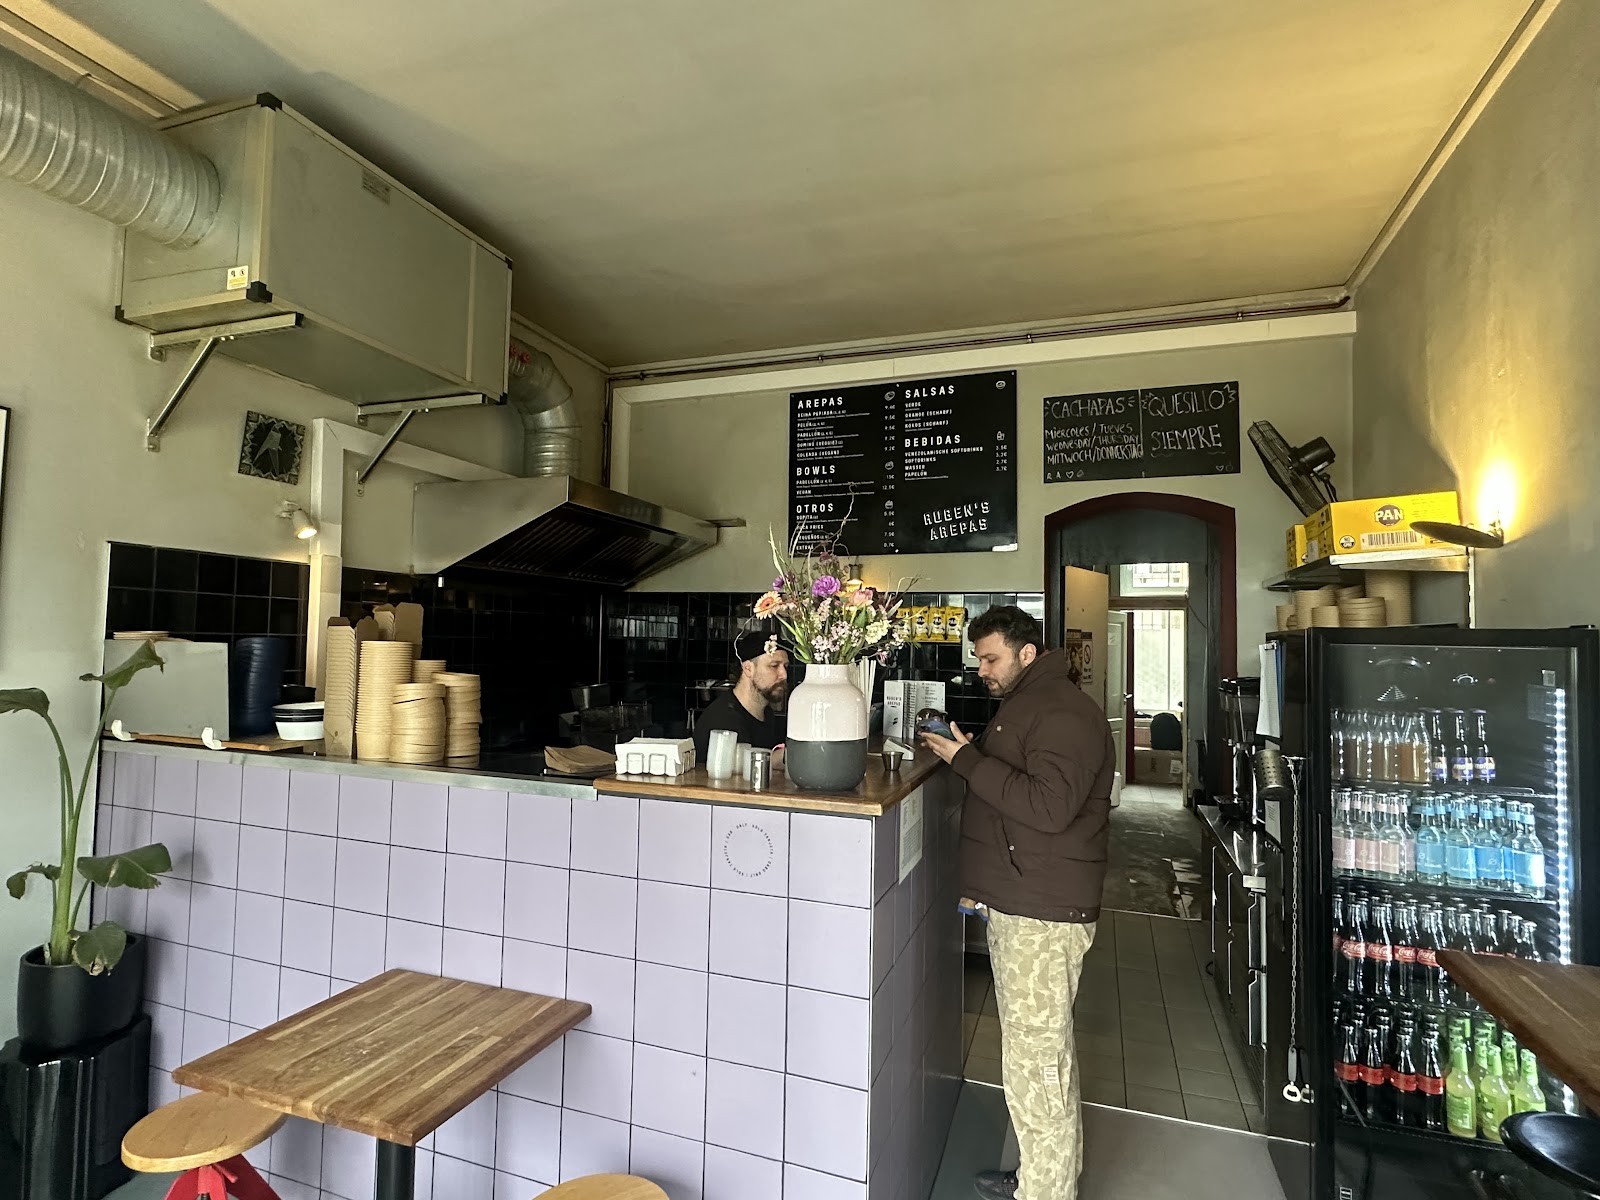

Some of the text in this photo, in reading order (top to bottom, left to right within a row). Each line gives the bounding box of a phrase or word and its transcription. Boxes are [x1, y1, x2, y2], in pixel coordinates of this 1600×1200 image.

[905, 385, 955, 398] SALSAS
[797, 396, 843, 409] AREPAS
[1051, 397, 1125, 419] CACHAPAS
[1148, 390, 1225, 418] QUESILLO
[904, 435, 961, 448] BEBIDAS
[1151, 424, 1223, 452] SIEMPRE
[796, 464, 836, 476] BOWLS
[796, 503, 834, 514] OTROS
[923, 501, 990, 526] RUBEN'S
[1375, 508, 1404, 522] PAN
[930, 518, 988, 541] AREPAS
